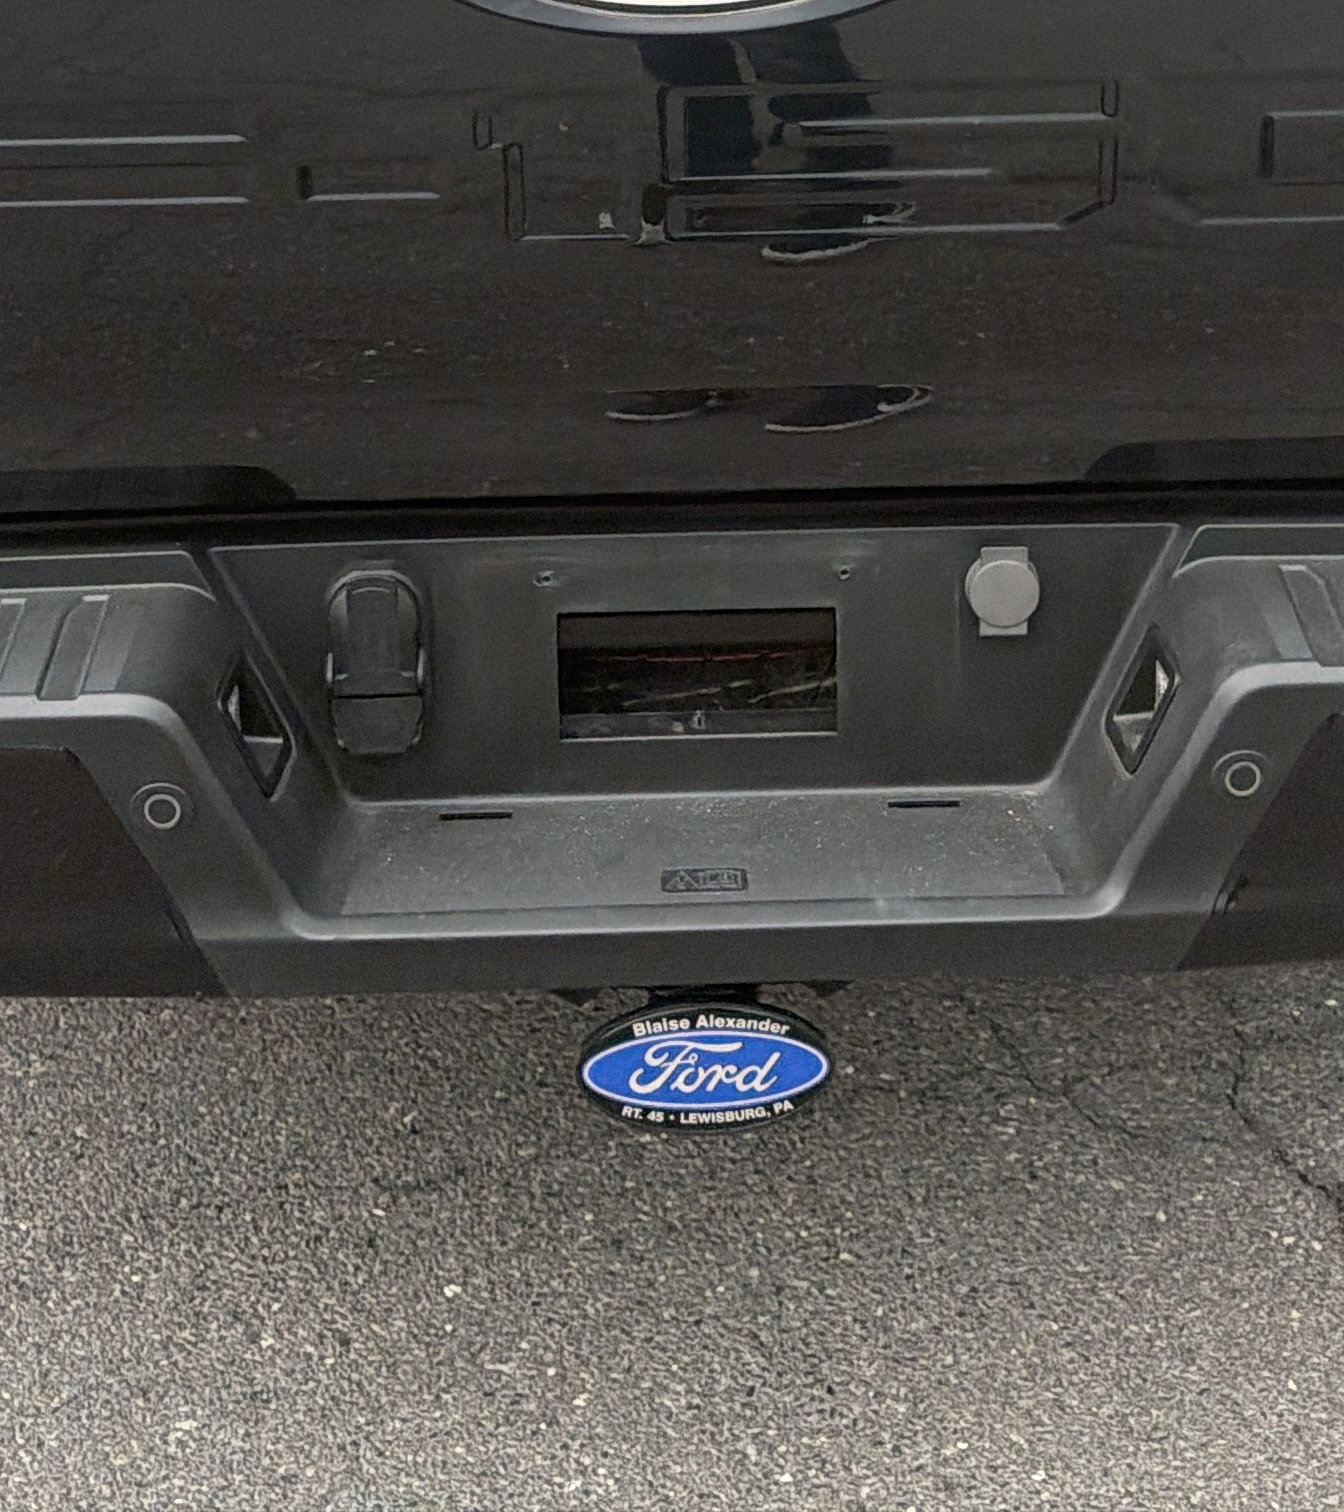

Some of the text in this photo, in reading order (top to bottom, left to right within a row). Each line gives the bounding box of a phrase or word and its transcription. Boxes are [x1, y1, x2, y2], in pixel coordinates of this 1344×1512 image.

[632, 1014, 791, 1038] Blaise Alexander
[628, 1040, 781, 1094] Ford
[621, 1099, 795, 1124] RT. 45 LEWISBURG, PA
